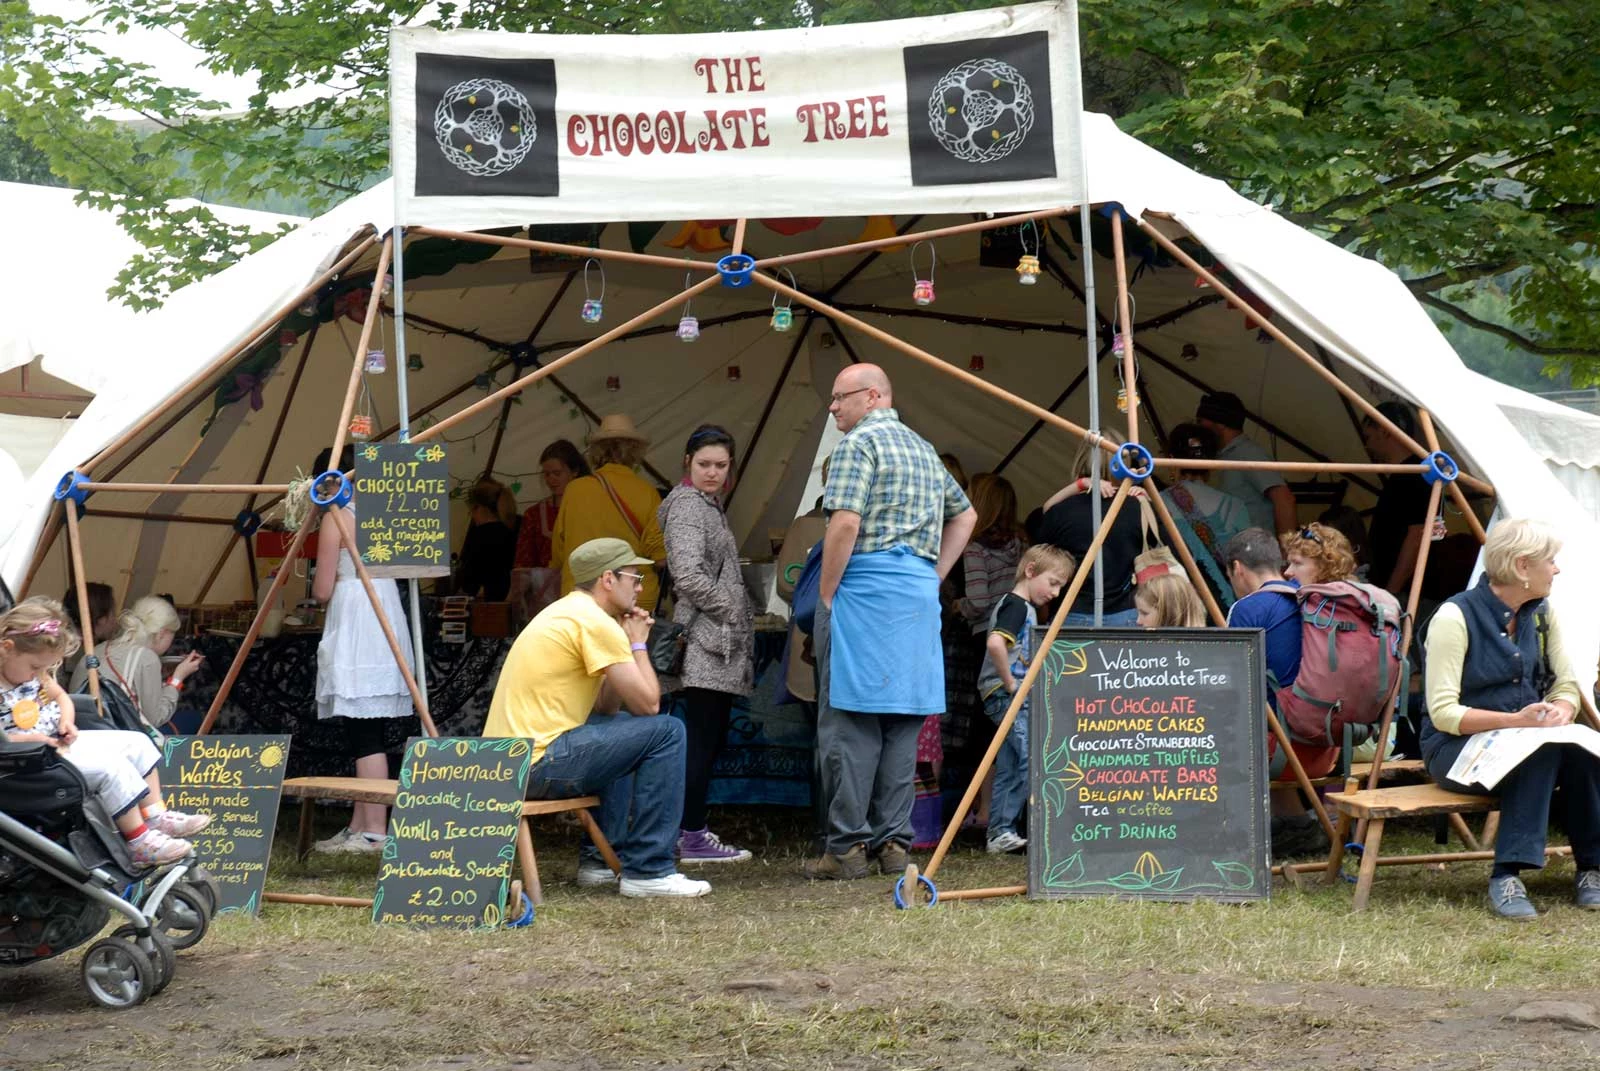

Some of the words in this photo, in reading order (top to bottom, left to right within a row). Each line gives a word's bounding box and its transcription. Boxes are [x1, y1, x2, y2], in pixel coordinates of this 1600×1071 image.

[694, 56, 765, 94] THE
[566, 107, 770, 157] CHOCOLATE
[796, 95, 889, 143] TREE
[382, 461, 419, 478] HOT
[356, 479, 446, 494] CHOCOLATE
[385, 493, 439, 513] £2.00
[360, 517, 386, 530] add
[391, 518, 440, 530] cream
[370, 528, 394, 541] and
[393, 541, 410, 556] for
[412, 544, 444, 564] 20p
[1098, 647, 1169, 671] Welcome
[1175, 650, 1191, 667] to
[1090, 672, 1121, 691] The
[1123, 670, 1196, 689] Chocolate
[1193, 668, 1227, 685] Tree
[1077, 718, 1153, 733] HANDMADE
[1157, 716, 1205, 733] CAKES
[1069, 735, 1133, 751] CHOCOLATE
[1134, 732, 1216, 750] STRAWBERRIES
[190, 740, 252, 767] Belgian
[1079, 752, 1150, 768] HANDMADE
[180, 761, 242, 786] Waffles
[411, 761, 514, 784] Homemade
[1085, 769, 1169, 785] CHOCOLATE
[1177, 767, 1217, 784] BARS
[166, 793, 175, 808] A
[179, 793, 209, 807] fresh
[213, 792, 249, 807] made
[396, 791, 462, 809] Chocolate
[464, 793, 485, 812] Ice
[1152, 785, 1218, 802] WAFFLES
[222, 810, 259, 824] served
[1080, 805, 1110, 816] Tea
[1129, 802, 1173, 816] Coffee
[232, 826, 264, 838] sauce
[391, 818, 440, 842] Vanilla
[444, 821, 467, 840] Ice
[469, 824, 518, 842] cream
[429, 846, 455, 863] and
[236, 862, 264, 871] cream
[379, 862, 408, 881] Dark
[406, 861, 464, 878] Chocolate
[465, 860, 511, 882] Sorbet
[441, 914, 453, 922] or
